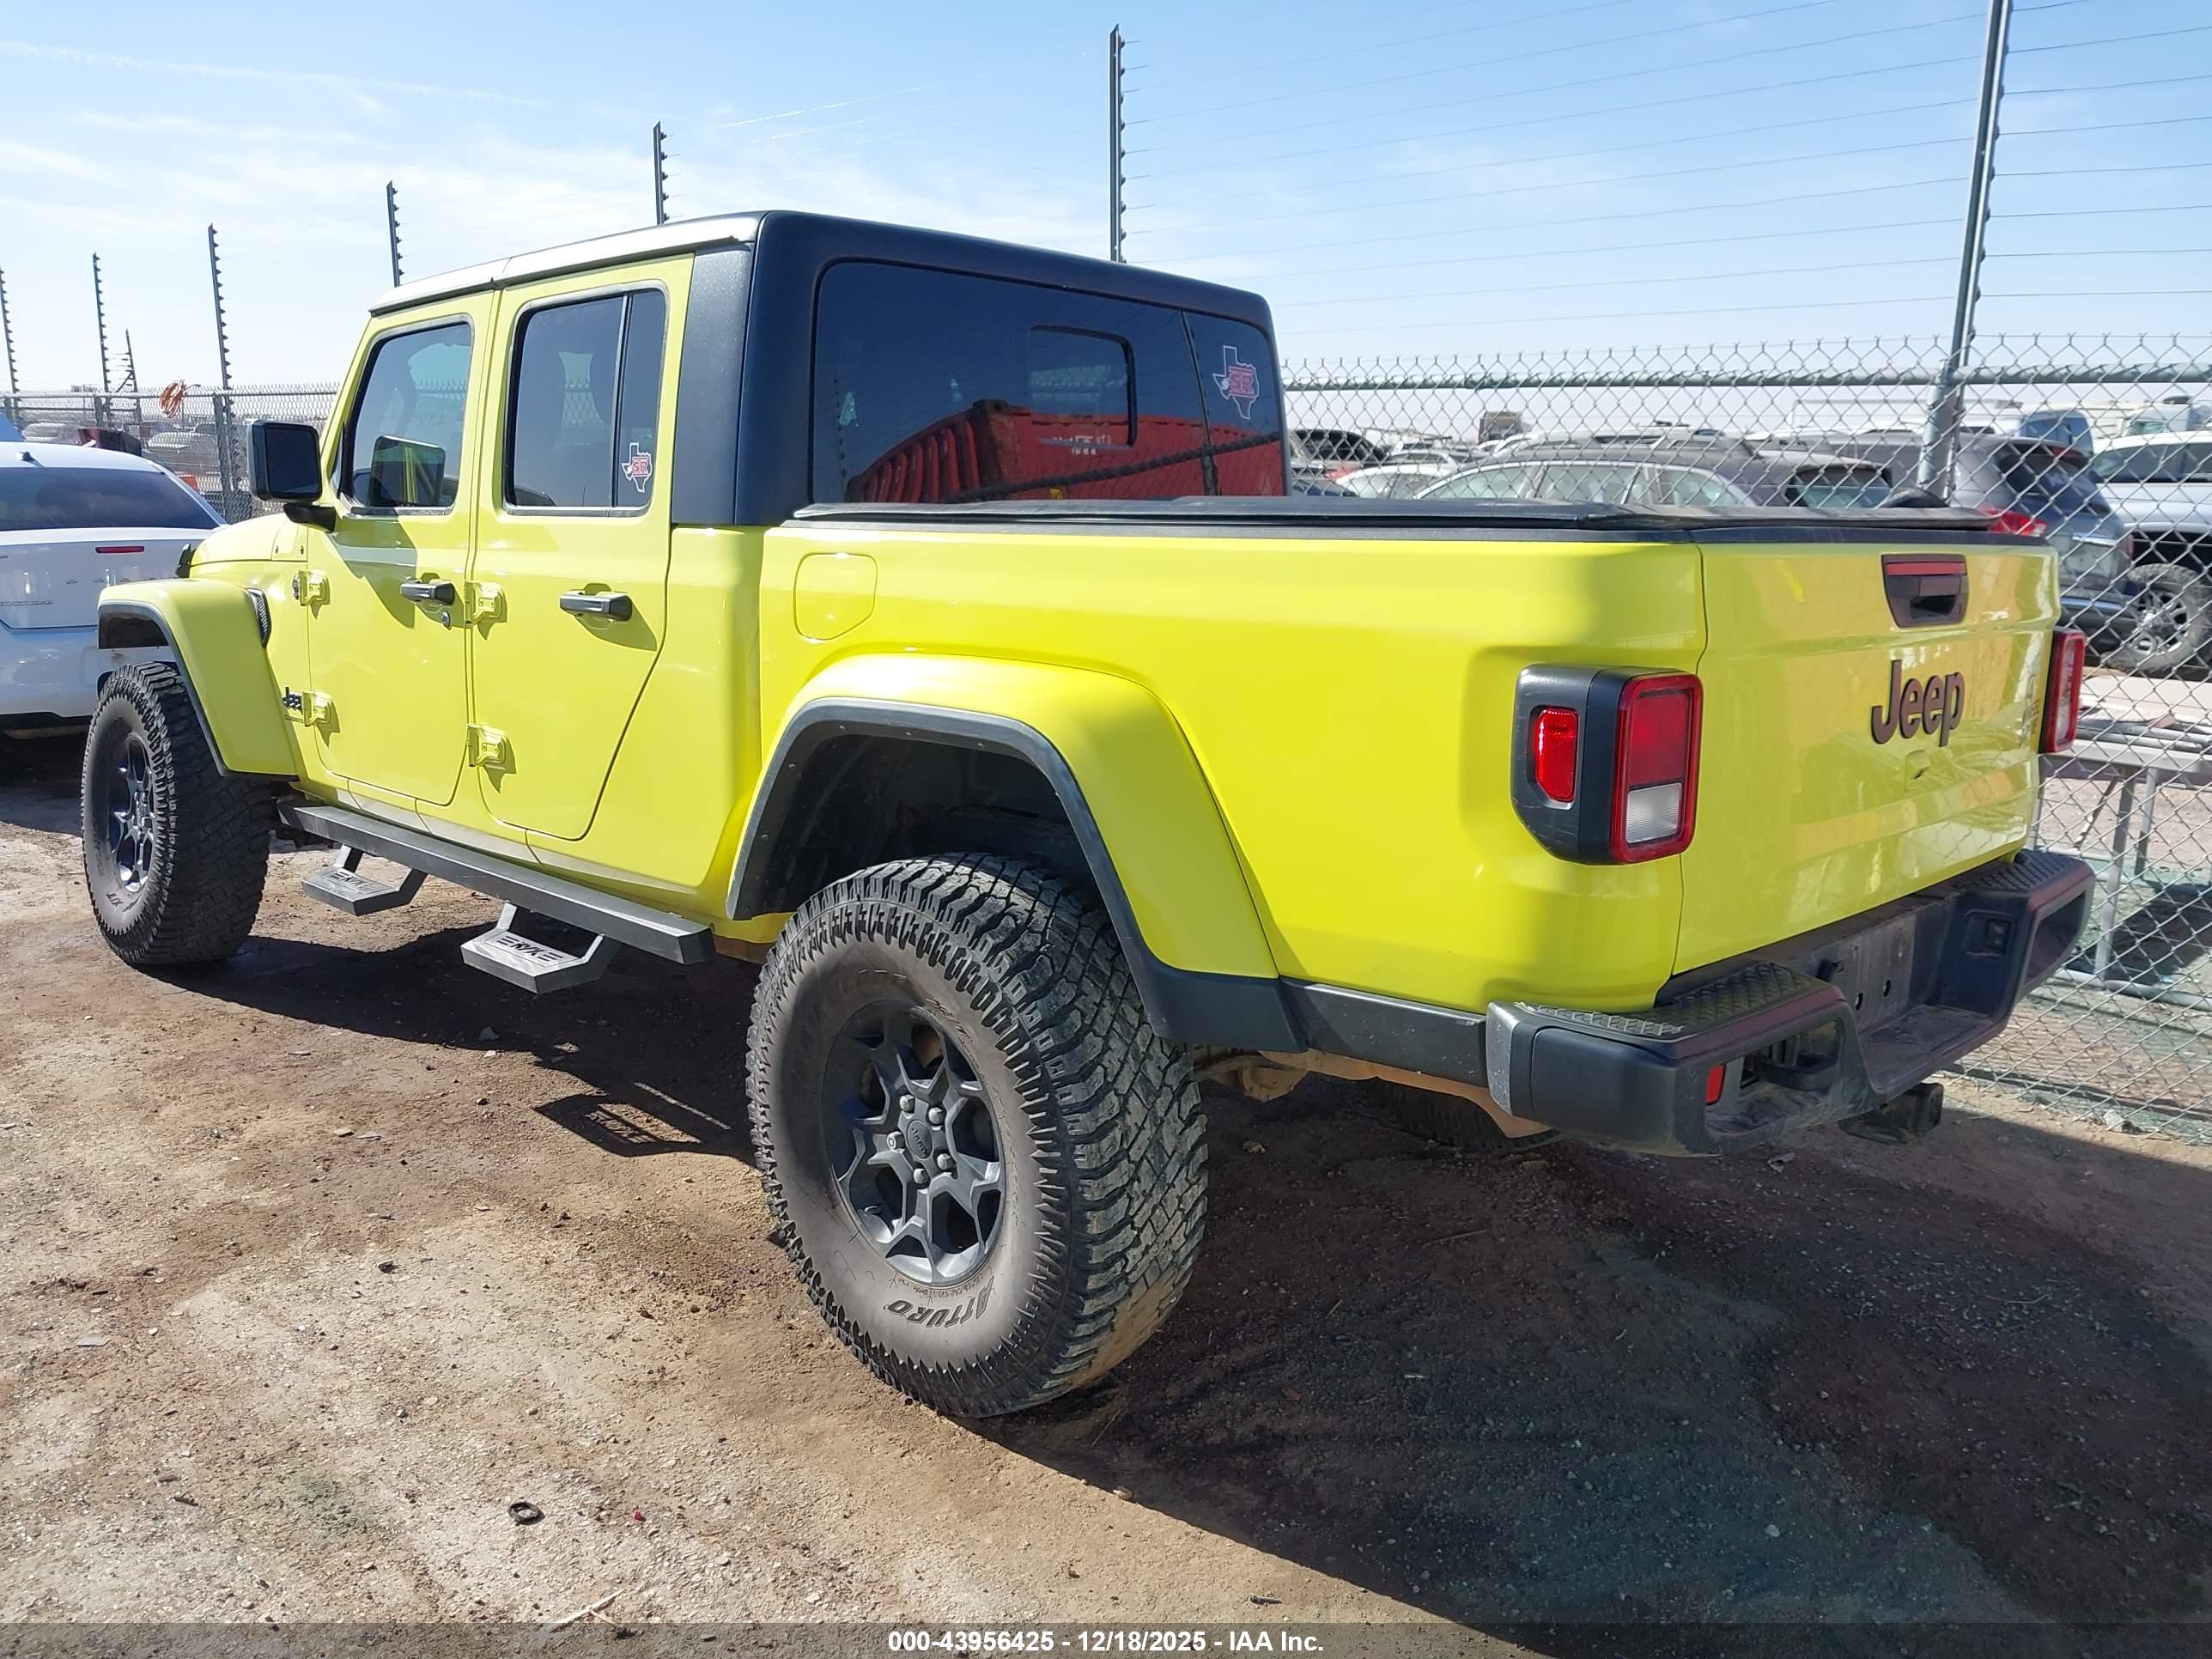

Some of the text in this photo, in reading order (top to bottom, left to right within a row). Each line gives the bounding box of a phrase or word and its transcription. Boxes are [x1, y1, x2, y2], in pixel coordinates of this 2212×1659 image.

[632, 459, 649, 474] SR
[1870, 659, 1966, 748] Jeep
[887, 1275, 995, 1328] ATTURO
